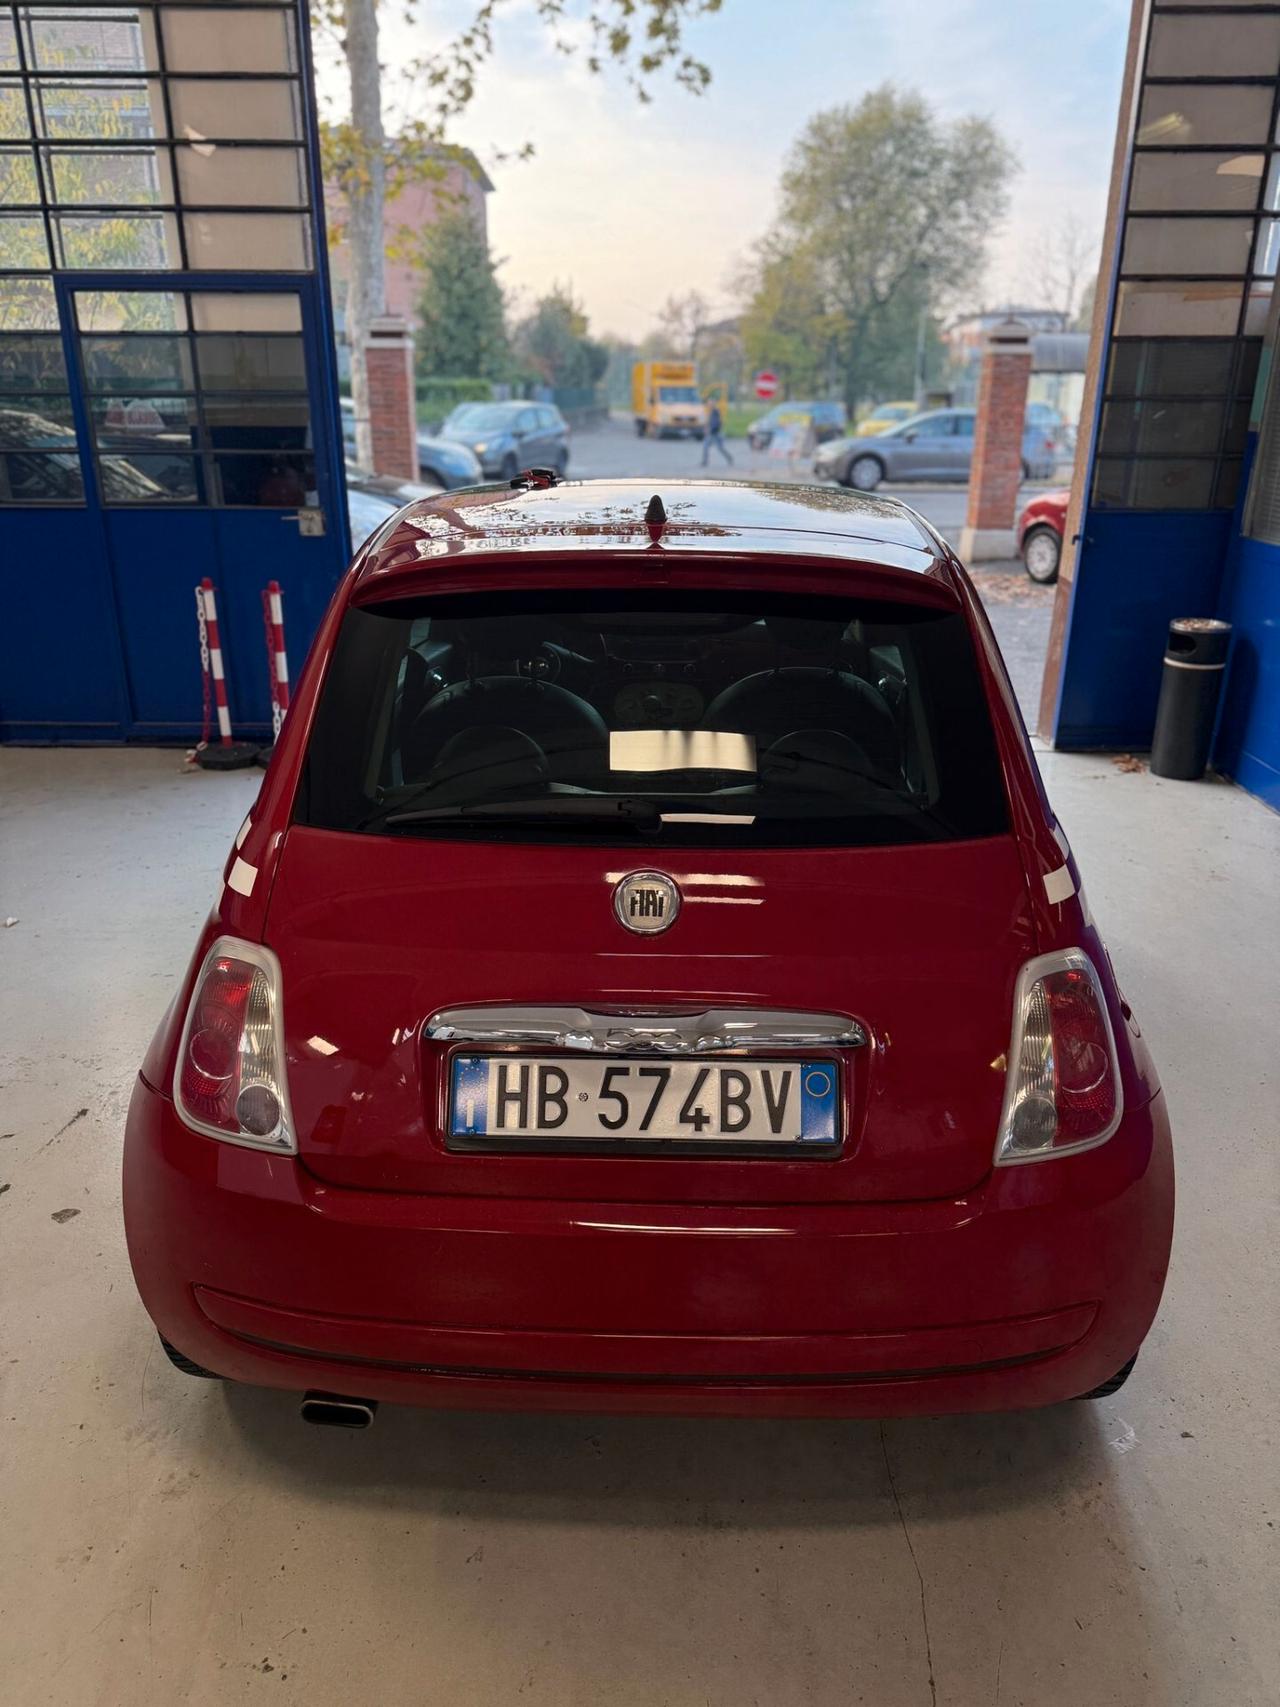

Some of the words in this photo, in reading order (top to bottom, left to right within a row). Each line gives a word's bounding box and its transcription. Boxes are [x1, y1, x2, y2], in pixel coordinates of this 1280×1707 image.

[630, 889, 664, 917] FIAT
[496, 1064, 569, 1129] HB
[597, 1067, 792, 1134] 574BV
